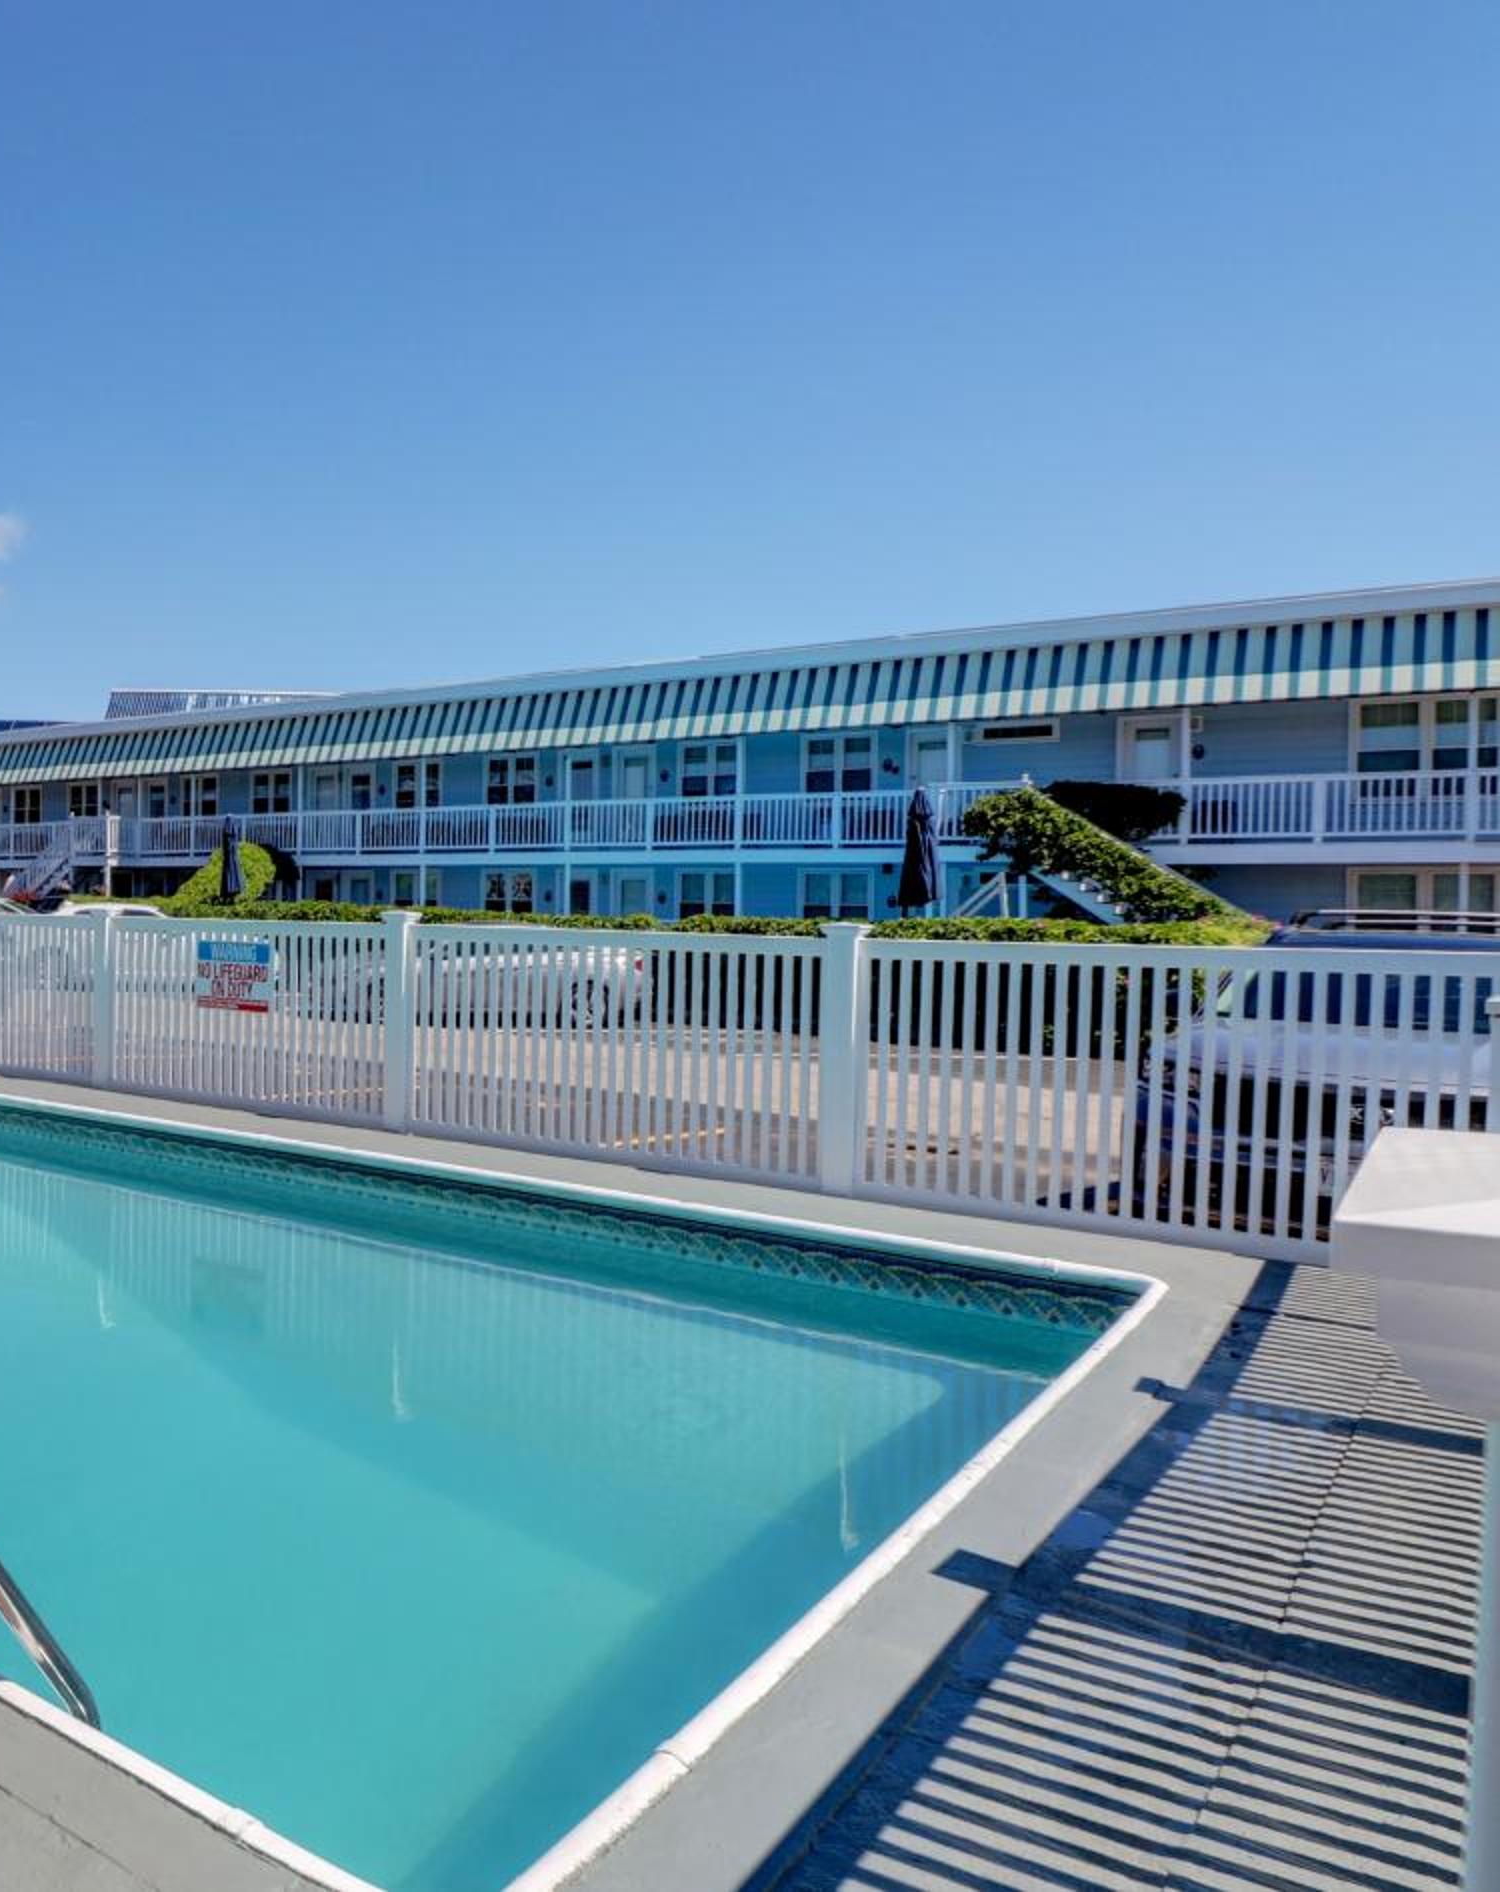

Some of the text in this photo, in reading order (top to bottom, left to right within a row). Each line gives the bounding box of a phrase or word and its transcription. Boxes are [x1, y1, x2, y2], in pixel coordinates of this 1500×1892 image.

[212, 943, 257, 961] WARNING
[197, 962, 268, 982] NO LIFEGUARD
[212, 980, 252, 997] ON DUTY
